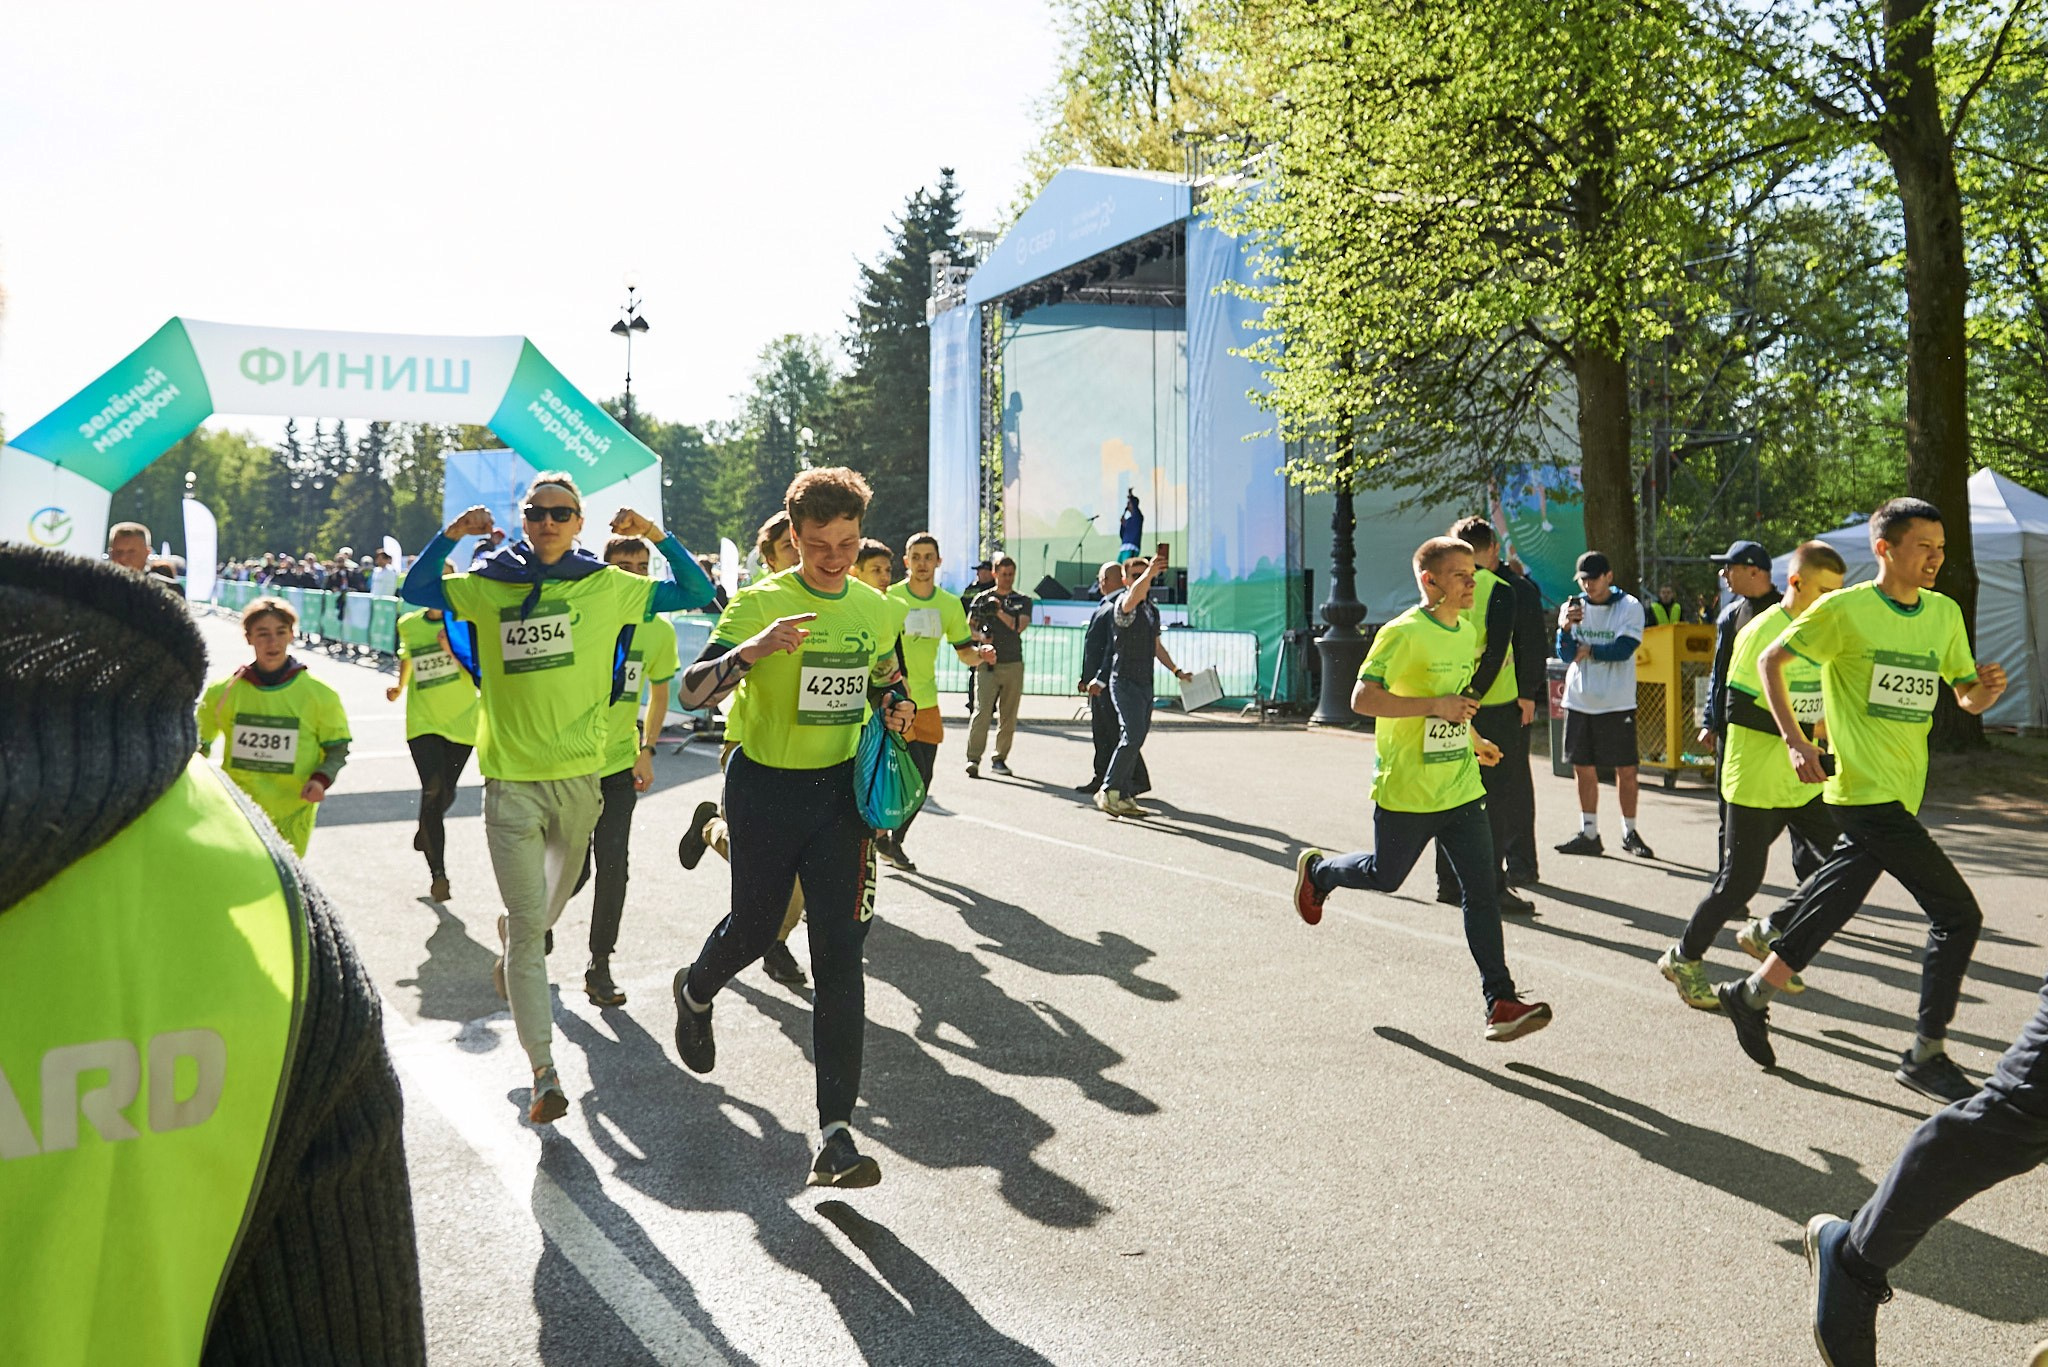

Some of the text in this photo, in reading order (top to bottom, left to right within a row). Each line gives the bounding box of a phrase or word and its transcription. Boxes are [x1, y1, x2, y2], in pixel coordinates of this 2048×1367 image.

[239, 347, 471, 394] ФИНИШ
[79, 366, 167, 439] зелёный
[92, 384, 180, 454] марафон
[527, 400, 599, 467] марафон
[540, 388, 612, 454] зелёный
[506, 622, 565, 646] 42354
[804, 636, 828, 646] афон
[807, 675, 864, 696] 42353
[1878, 673, 1934, 696] 42335
[237, 732, 291, 751] 42381
